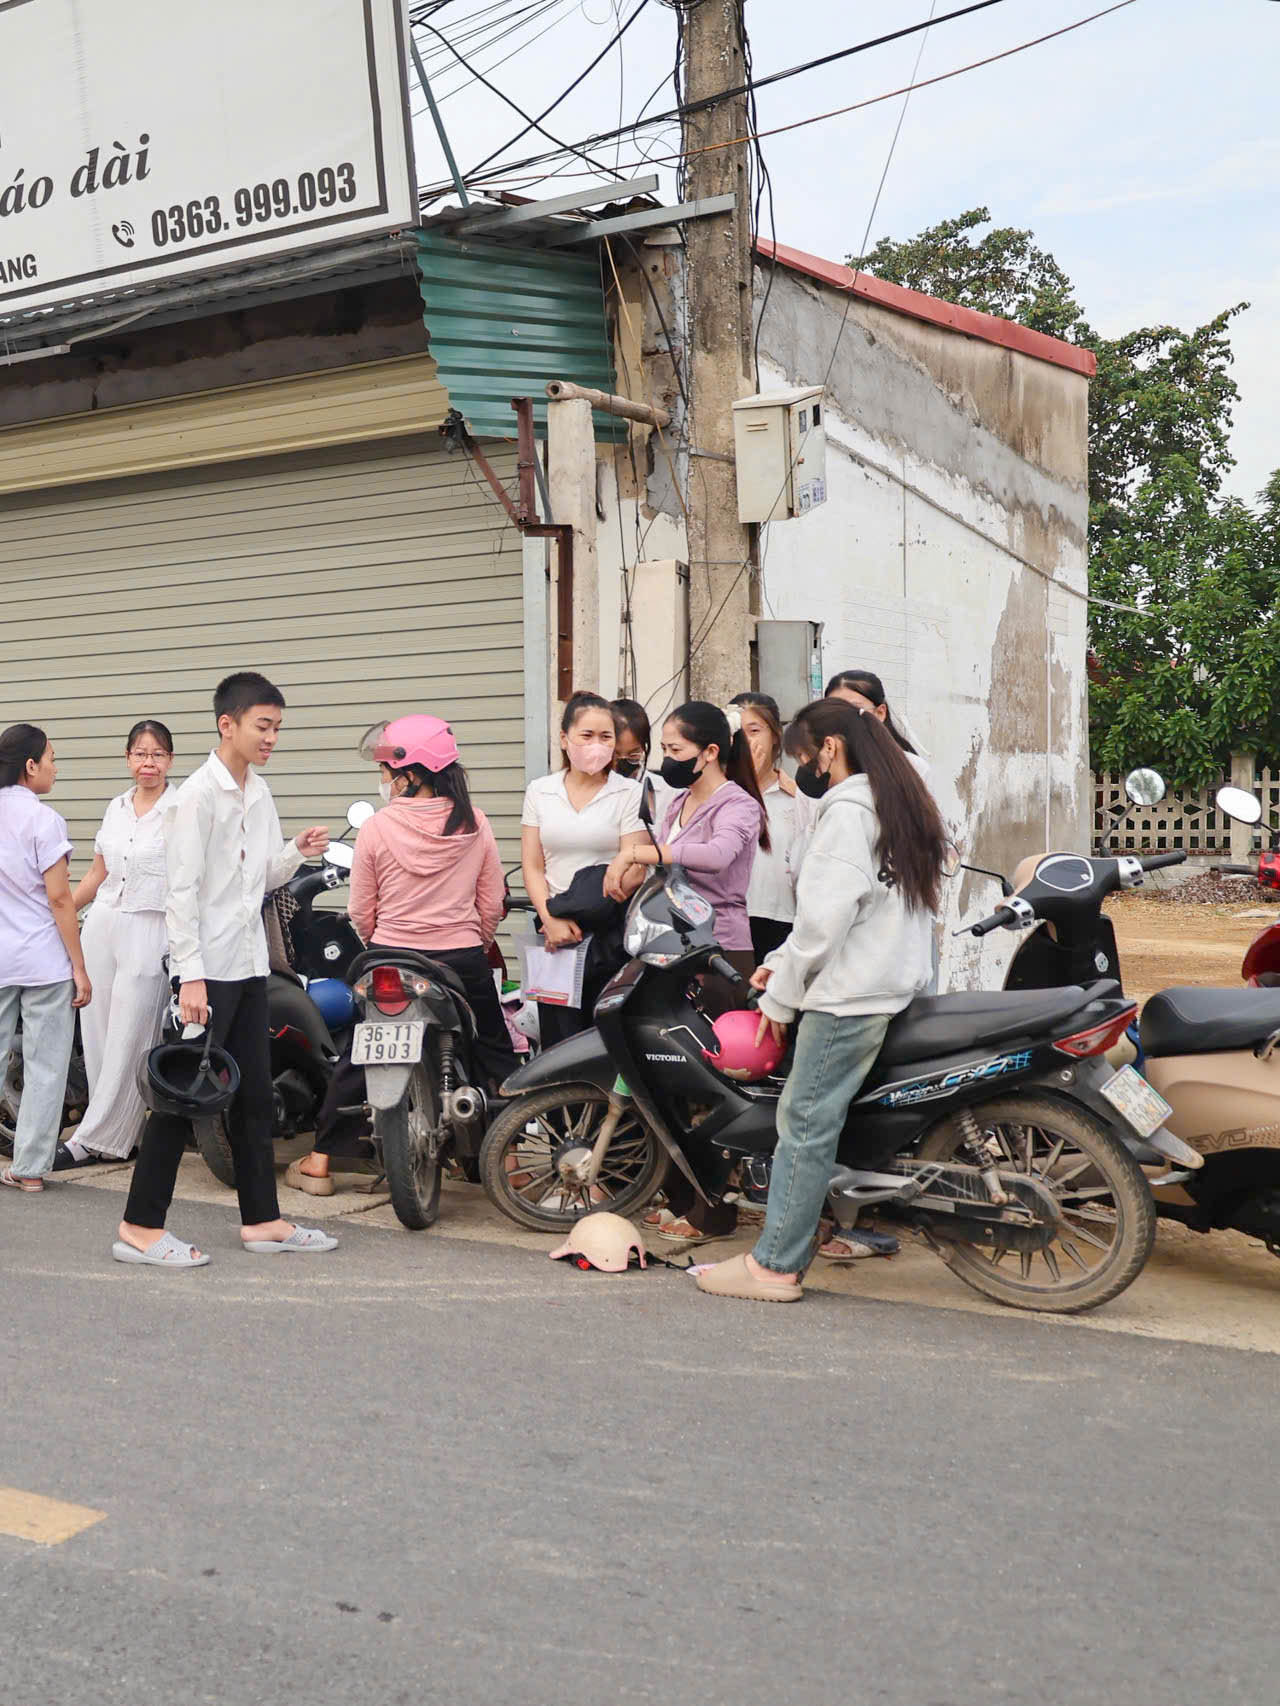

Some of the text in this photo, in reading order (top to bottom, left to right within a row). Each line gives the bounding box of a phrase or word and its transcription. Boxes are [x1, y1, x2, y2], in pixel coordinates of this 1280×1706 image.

[70, 133, 151, 198] dài
[364, 1025, 411, 1042] 36-T1
[364, 1043, 410, 1060] 1903
[645, 1053, 688, 1063] VICTORIA
